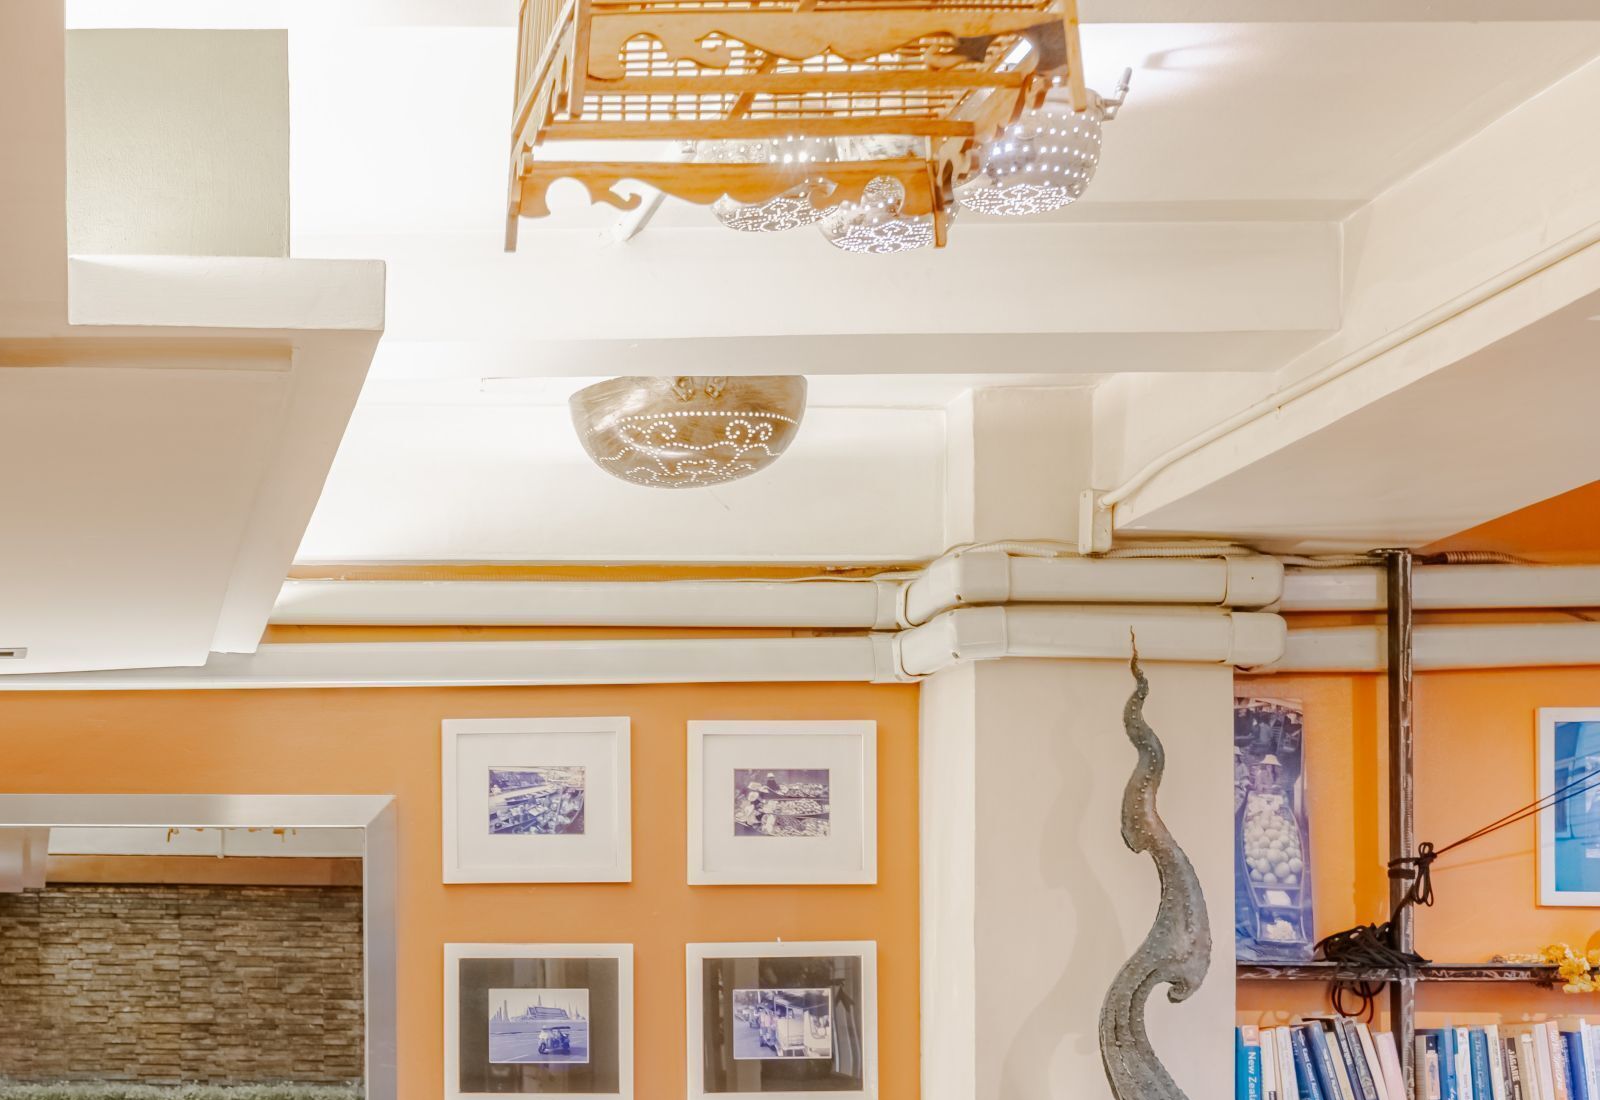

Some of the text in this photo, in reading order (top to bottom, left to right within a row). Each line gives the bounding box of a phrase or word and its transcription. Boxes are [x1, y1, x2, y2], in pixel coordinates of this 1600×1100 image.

[1248, 1052, 1257, 1075] New
[1302, 1048, 1311, 1062] East
[1305, 1063, 1316, 1081] Coast
